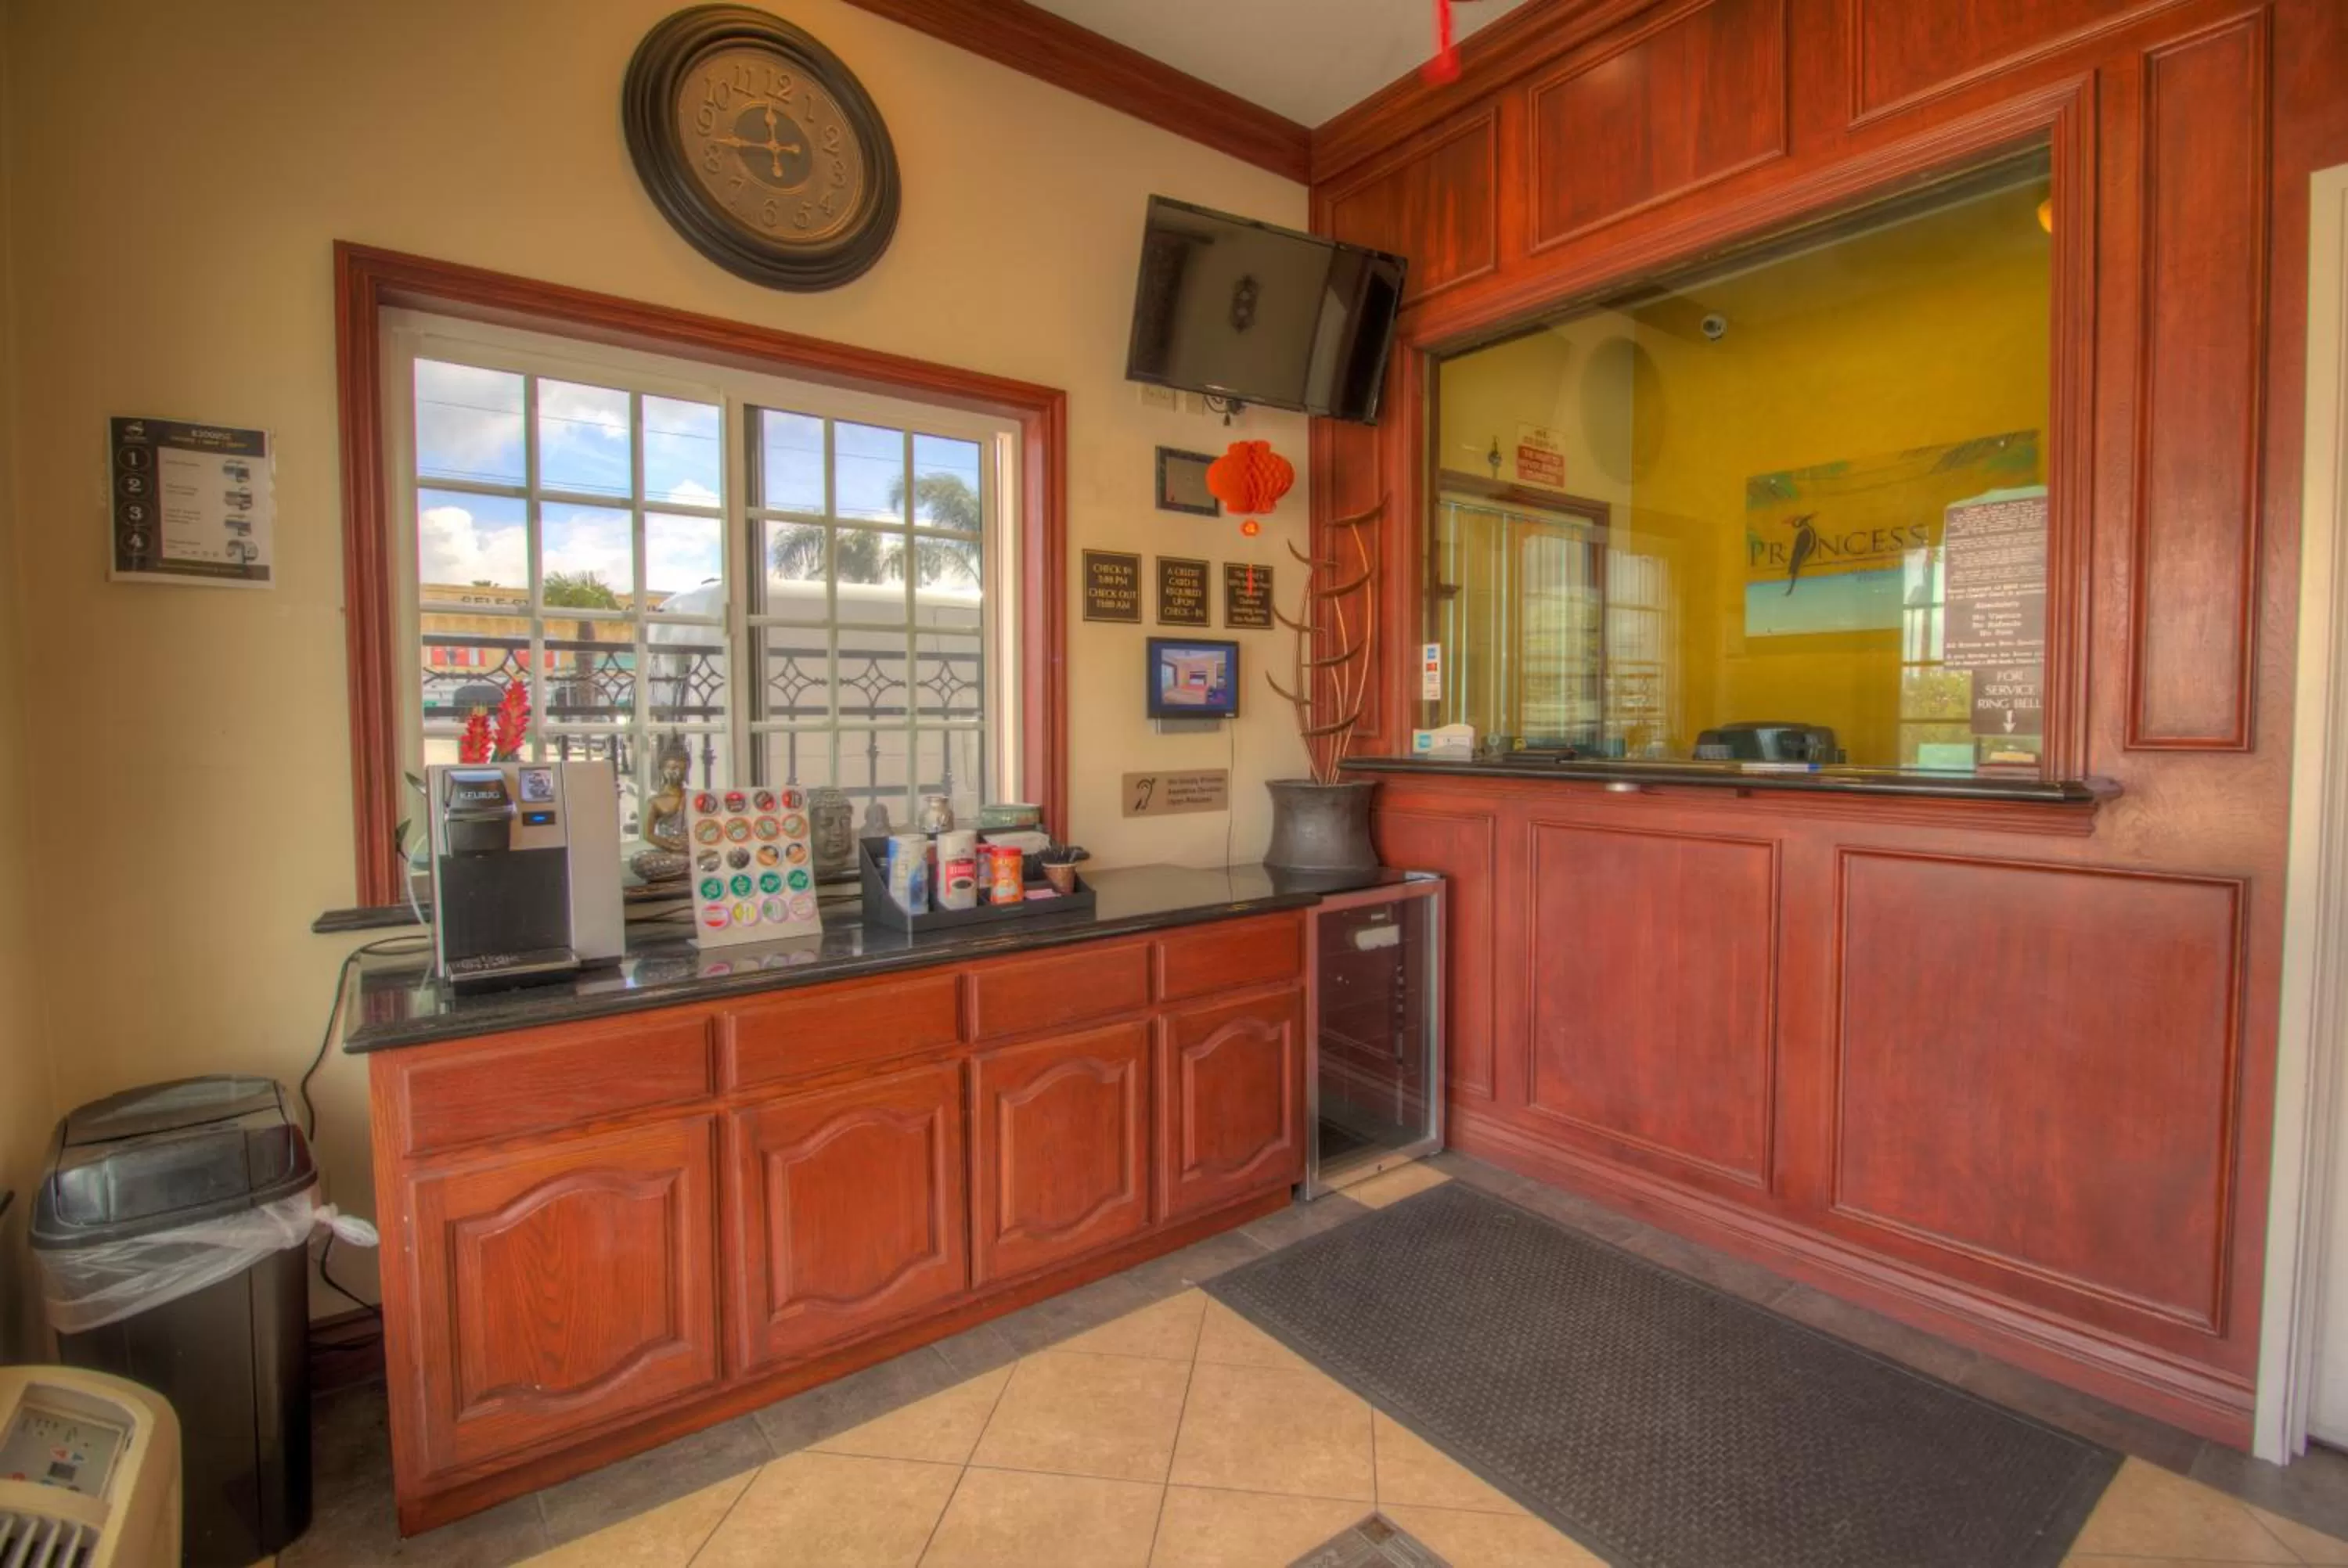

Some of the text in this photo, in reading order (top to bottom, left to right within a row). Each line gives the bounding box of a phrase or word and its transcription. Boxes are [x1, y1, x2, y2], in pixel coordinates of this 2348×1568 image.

[764, 68, 794, 105] 12
[704, 77, 732, 112] 10
[128, 479, 142, 492] 2
[128, 506, 142, 520] 3
[1093, 563, 1122, 574] CHECK
[1115, 575, 1128, 585] PM
[1169, 577, 1190, 586] CARD
[1089, 588, 1136, 599] CHECK OUT
[1165, 586, 1202, 597] REQUIRED
[1116, 600, 1130, 609] AM
[1172, 597, 1196, 606] UPON
[1997, 670, 2023, 682] FOR
[1984, 684, 2036, 696] SERVICE
[1978, 697, 2042, 709] RING BELL
[459, 790, 501, 800] KEURIG
